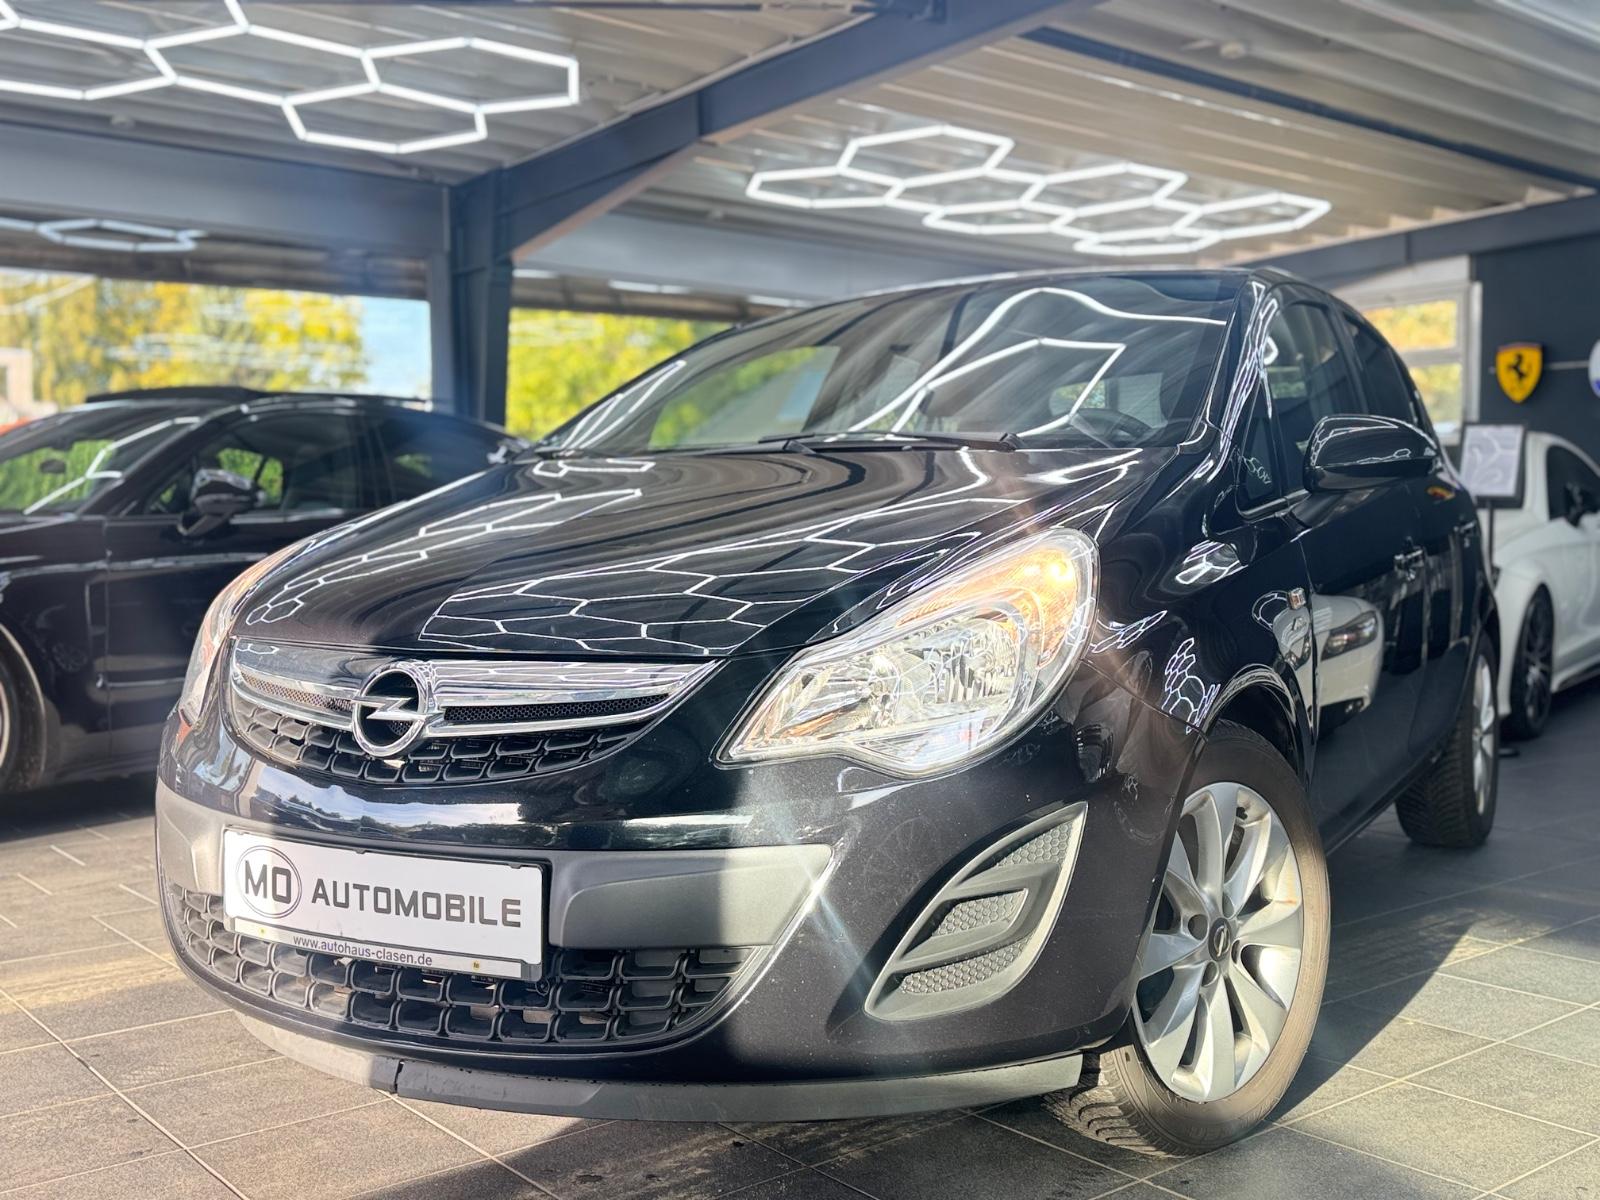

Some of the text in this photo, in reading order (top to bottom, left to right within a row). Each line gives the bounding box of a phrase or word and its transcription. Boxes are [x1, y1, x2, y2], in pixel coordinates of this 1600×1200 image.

[245, 860, 521, 928] MO AUTOMOBILE
[293, 935, 433, 966] www.autohaus-clasen.de
